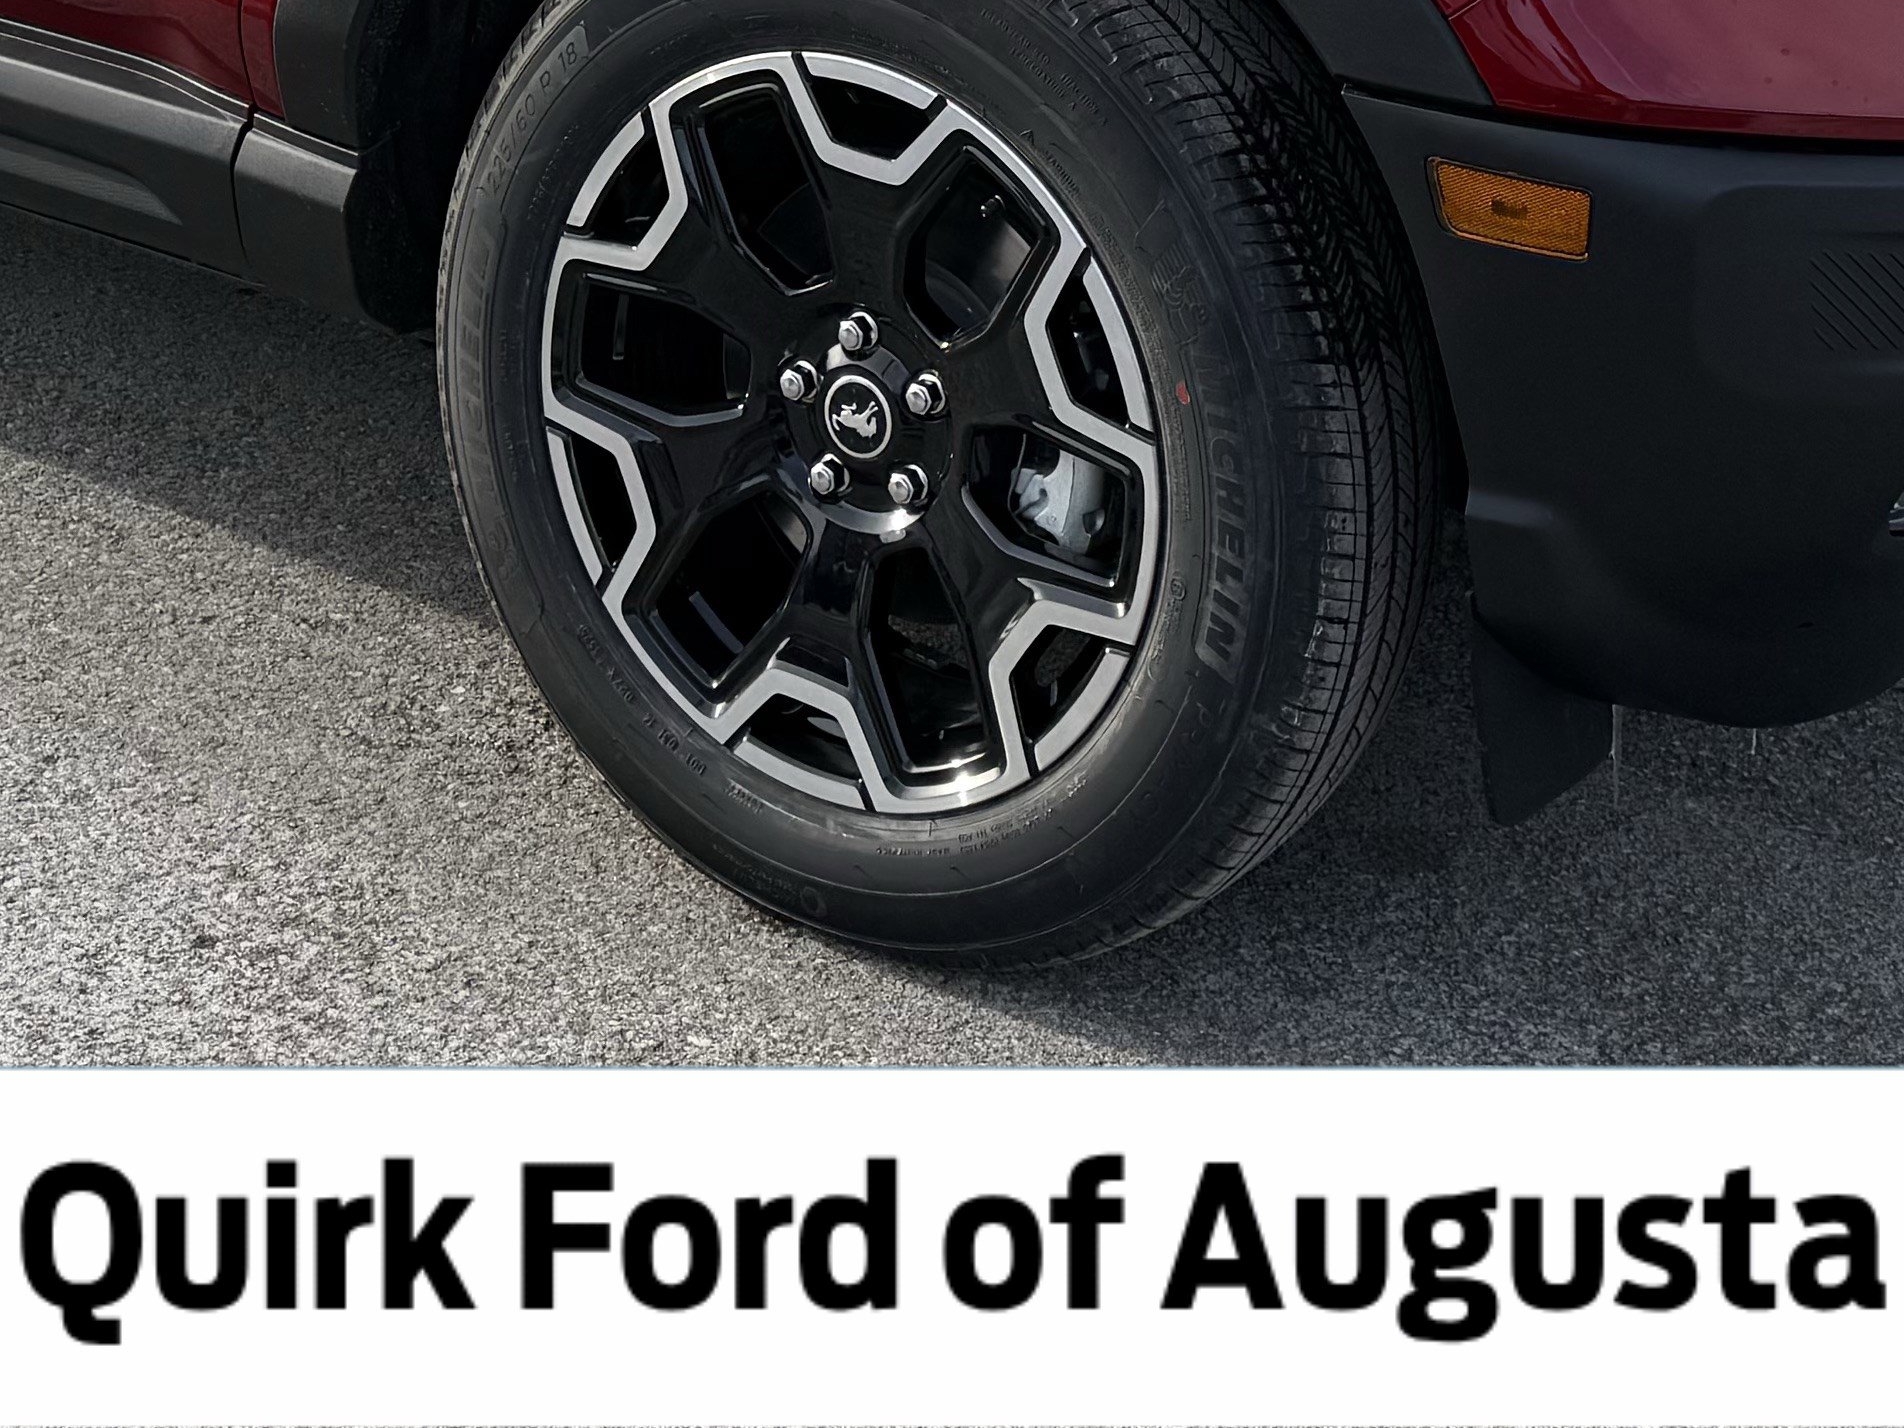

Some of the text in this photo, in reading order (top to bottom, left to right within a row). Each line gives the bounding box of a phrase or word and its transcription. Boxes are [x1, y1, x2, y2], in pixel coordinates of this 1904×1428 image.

[487, 92, 536, 193] 225/60
[557, 42, 578, 72] 18
[1191, 349, 1249, 671] MICHELIN
